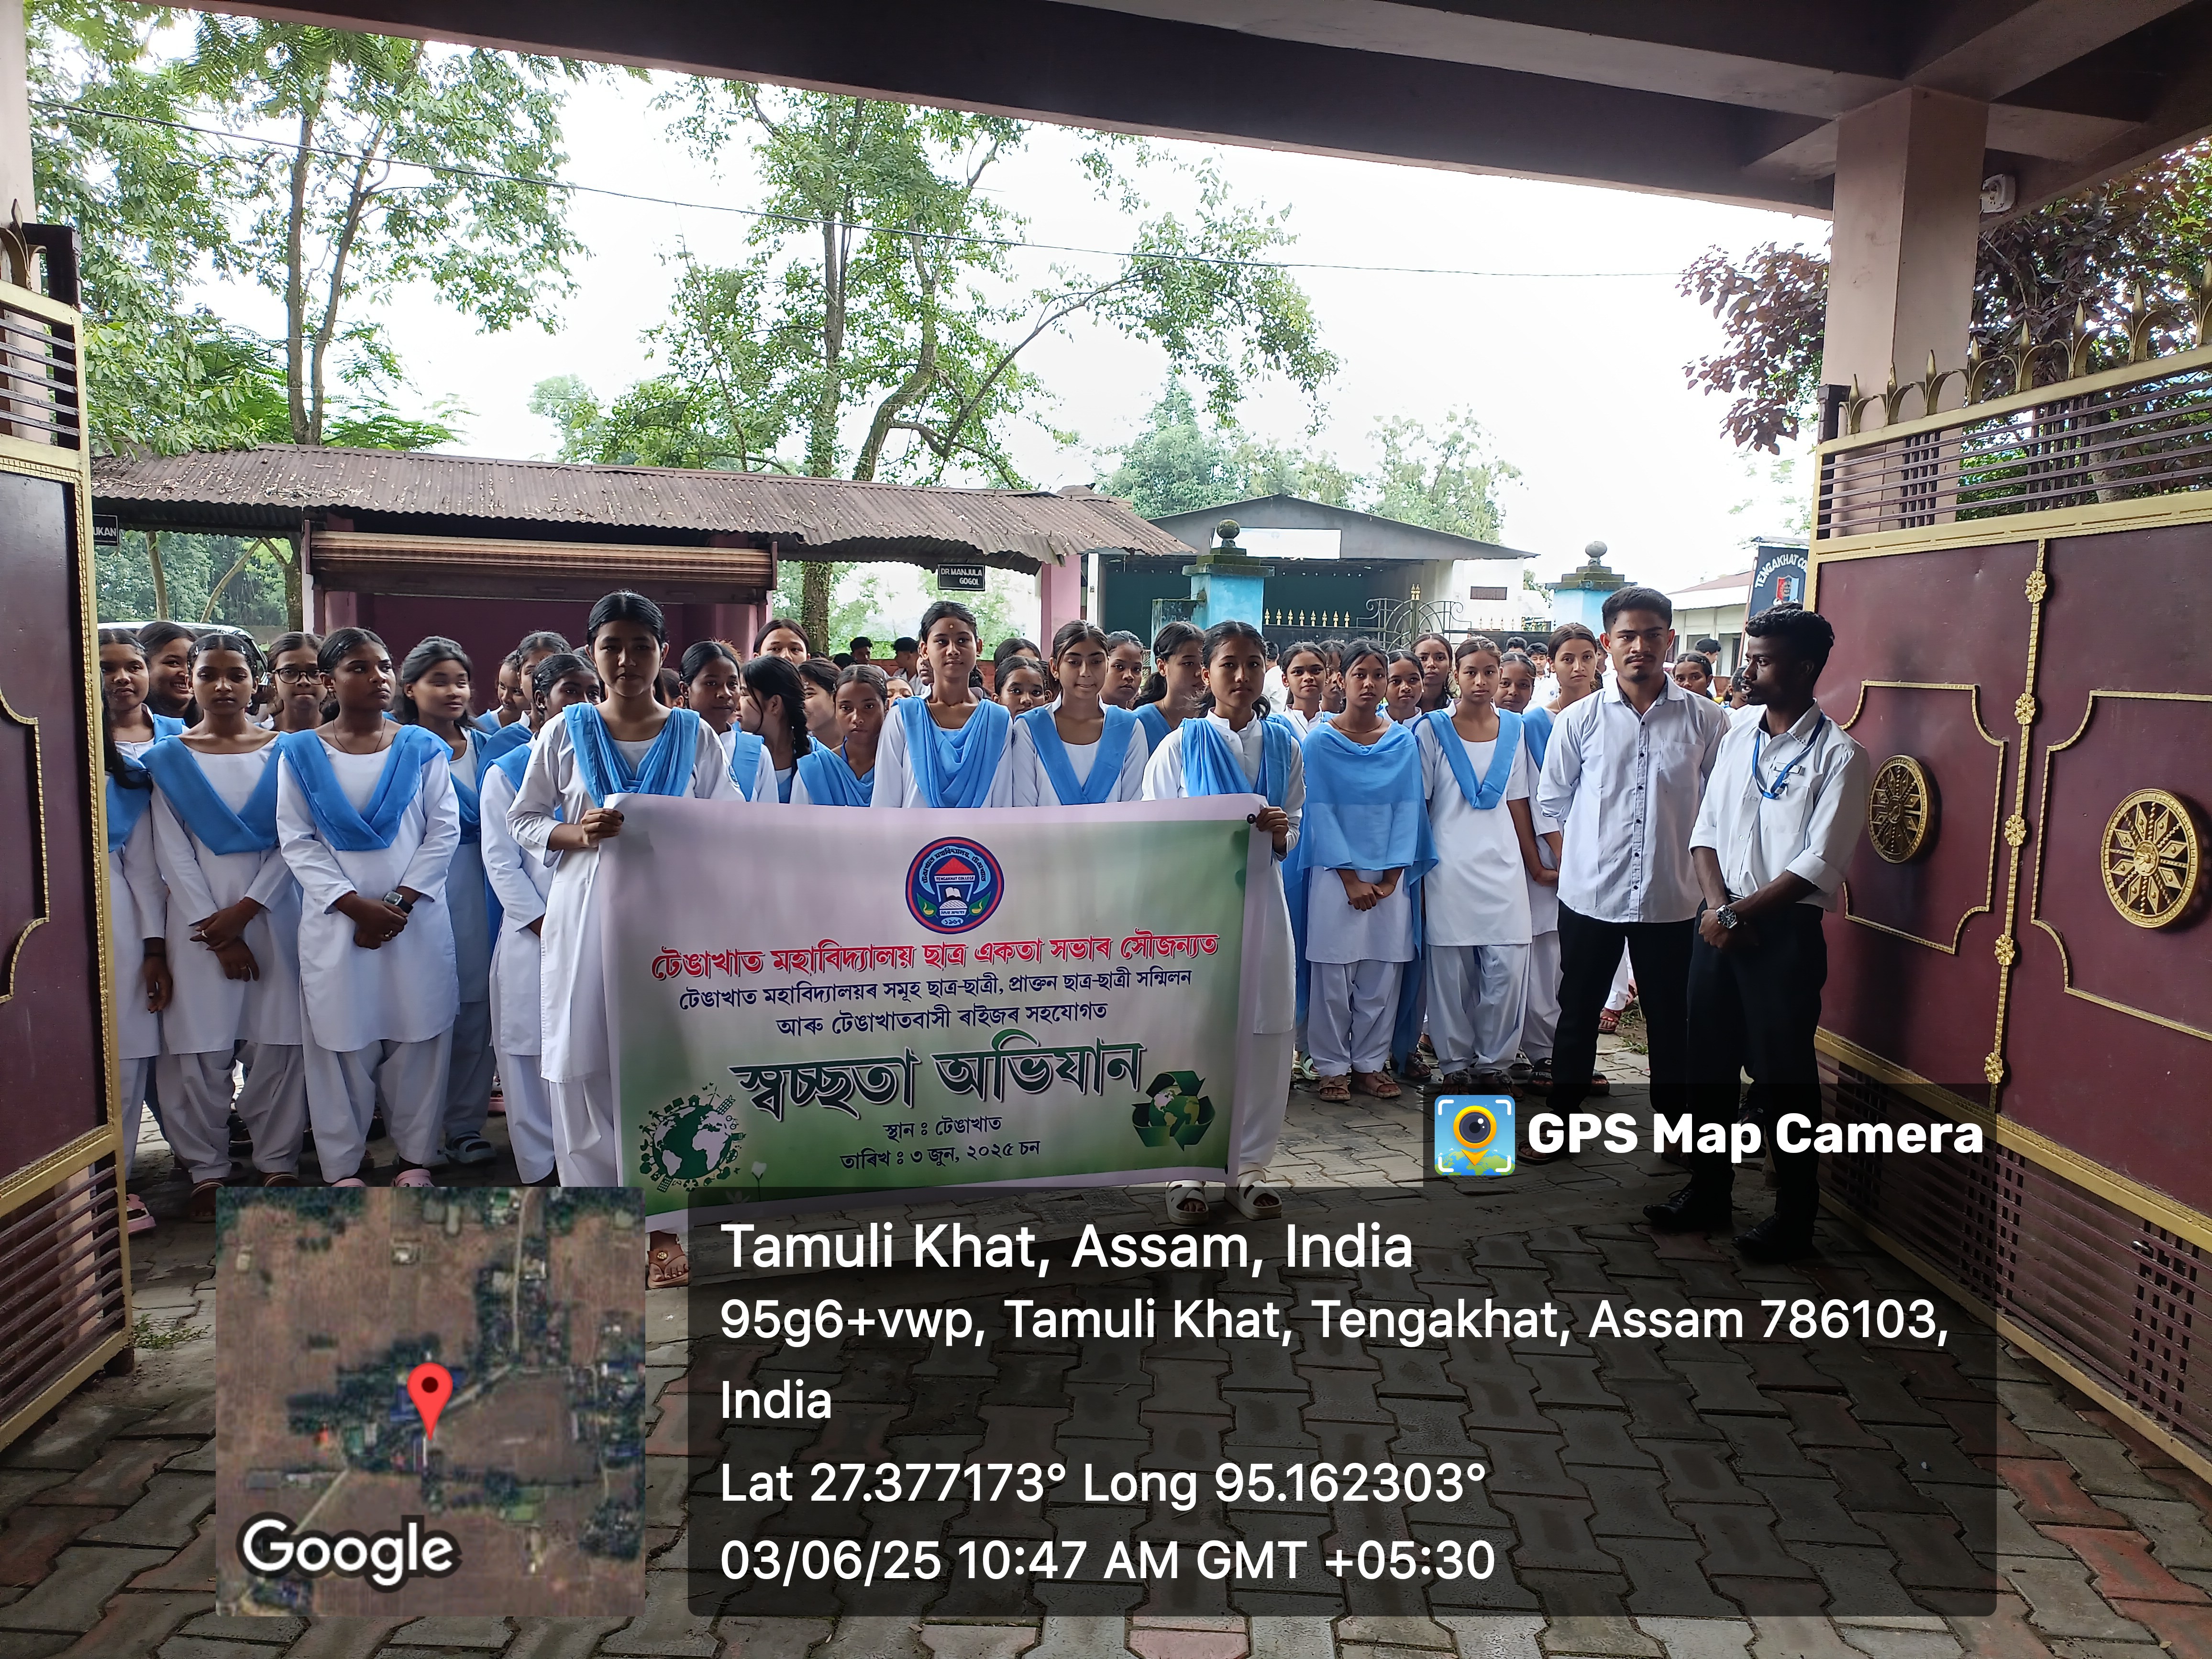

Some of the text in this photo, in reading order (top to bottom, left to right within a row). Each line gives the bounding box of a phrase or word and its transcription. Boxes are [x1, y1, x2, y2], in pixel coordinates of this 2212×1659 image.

[1755, 554, 1799, 588] TENGAKHAT
[652, 946, 764, 980] টেঙাখাত
[770, 939, 916, 976] মহাবিদ্যালয়
[974, 937, 1044, 963] একতা
[1050, 935, 1113, 961] সভাৰ
[1120, 928, 1220, 959] সৌজন্যত
[680, 987, 758, 1009] টেঙাখাত
[763, 981, 878, 1006] মহাবিদ্যালয়ৰ
[883, 982, 922, 1002] সমূহ
[1136, 965, 1193, 987] সন্মিলন
[775, 1001, 1108, 1037] আৰু টেঙাখাতবাসী ৰাইজৰ সহযোগত
[730, 1029, 1147, 1121] স্বচ্ছতা অভিযান
[885, 1122, 915, 1143] স্থান
[935, 1116, 1003, 1136] টেঙাখাত
[841, 1150, 892, 1170] তাৰিখ
[910, 1150, 923, 1163] ৩
[928, 1147, 960, 1168] জুন,
[967, 1143, 1014, 1161] ২০২৫
[1018, 1140, 1041, 1155] চন
